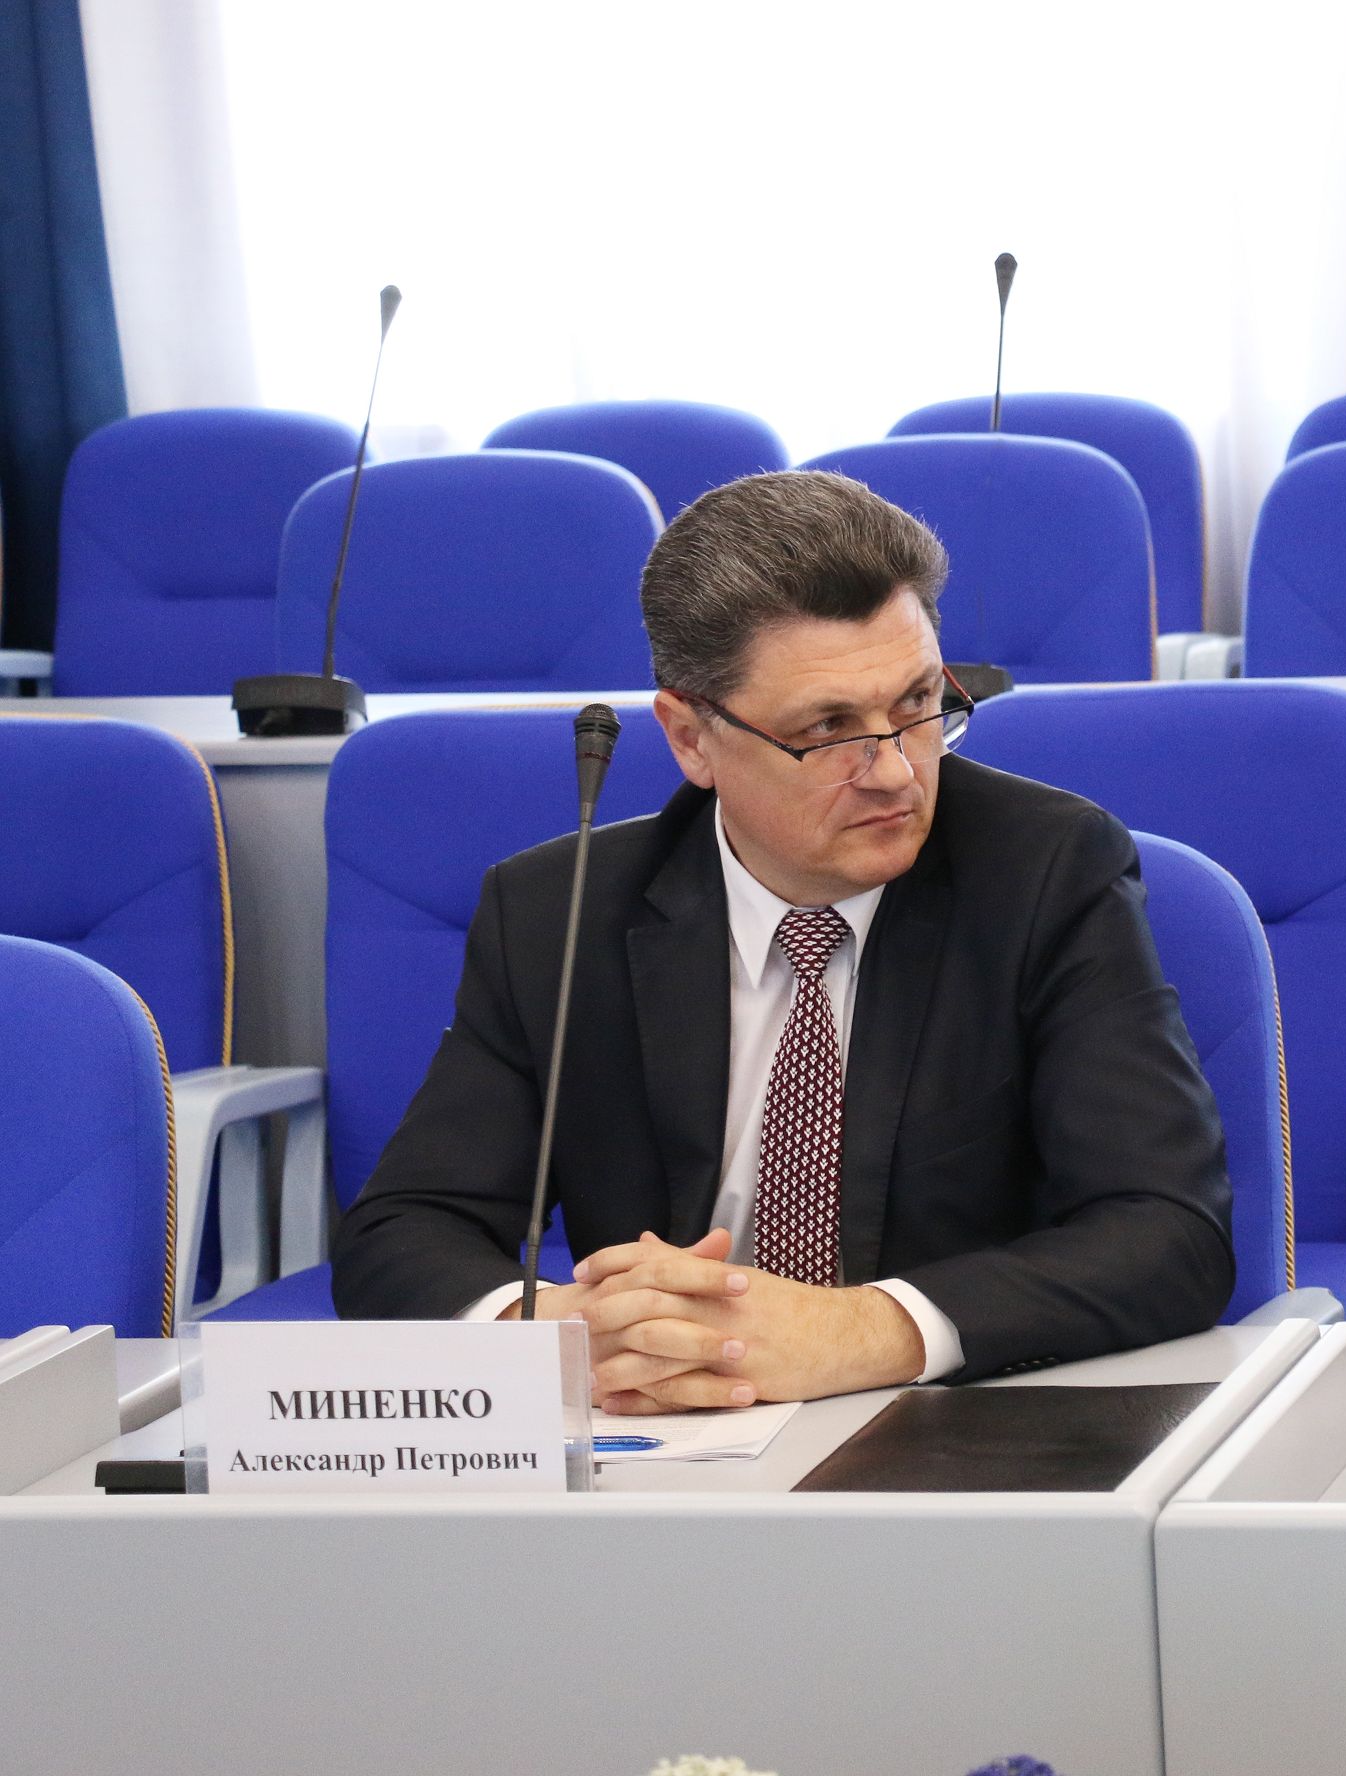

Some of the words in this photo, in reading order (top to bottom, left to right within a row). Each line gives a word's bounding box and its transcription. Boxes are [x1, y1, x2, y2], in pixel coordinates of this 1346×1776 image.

[268, 1389, 492, 1420] МИНЕНКО
[230, 1448, 385, 1477] Александр
[396, 1447, 538, 1477] Петрович
